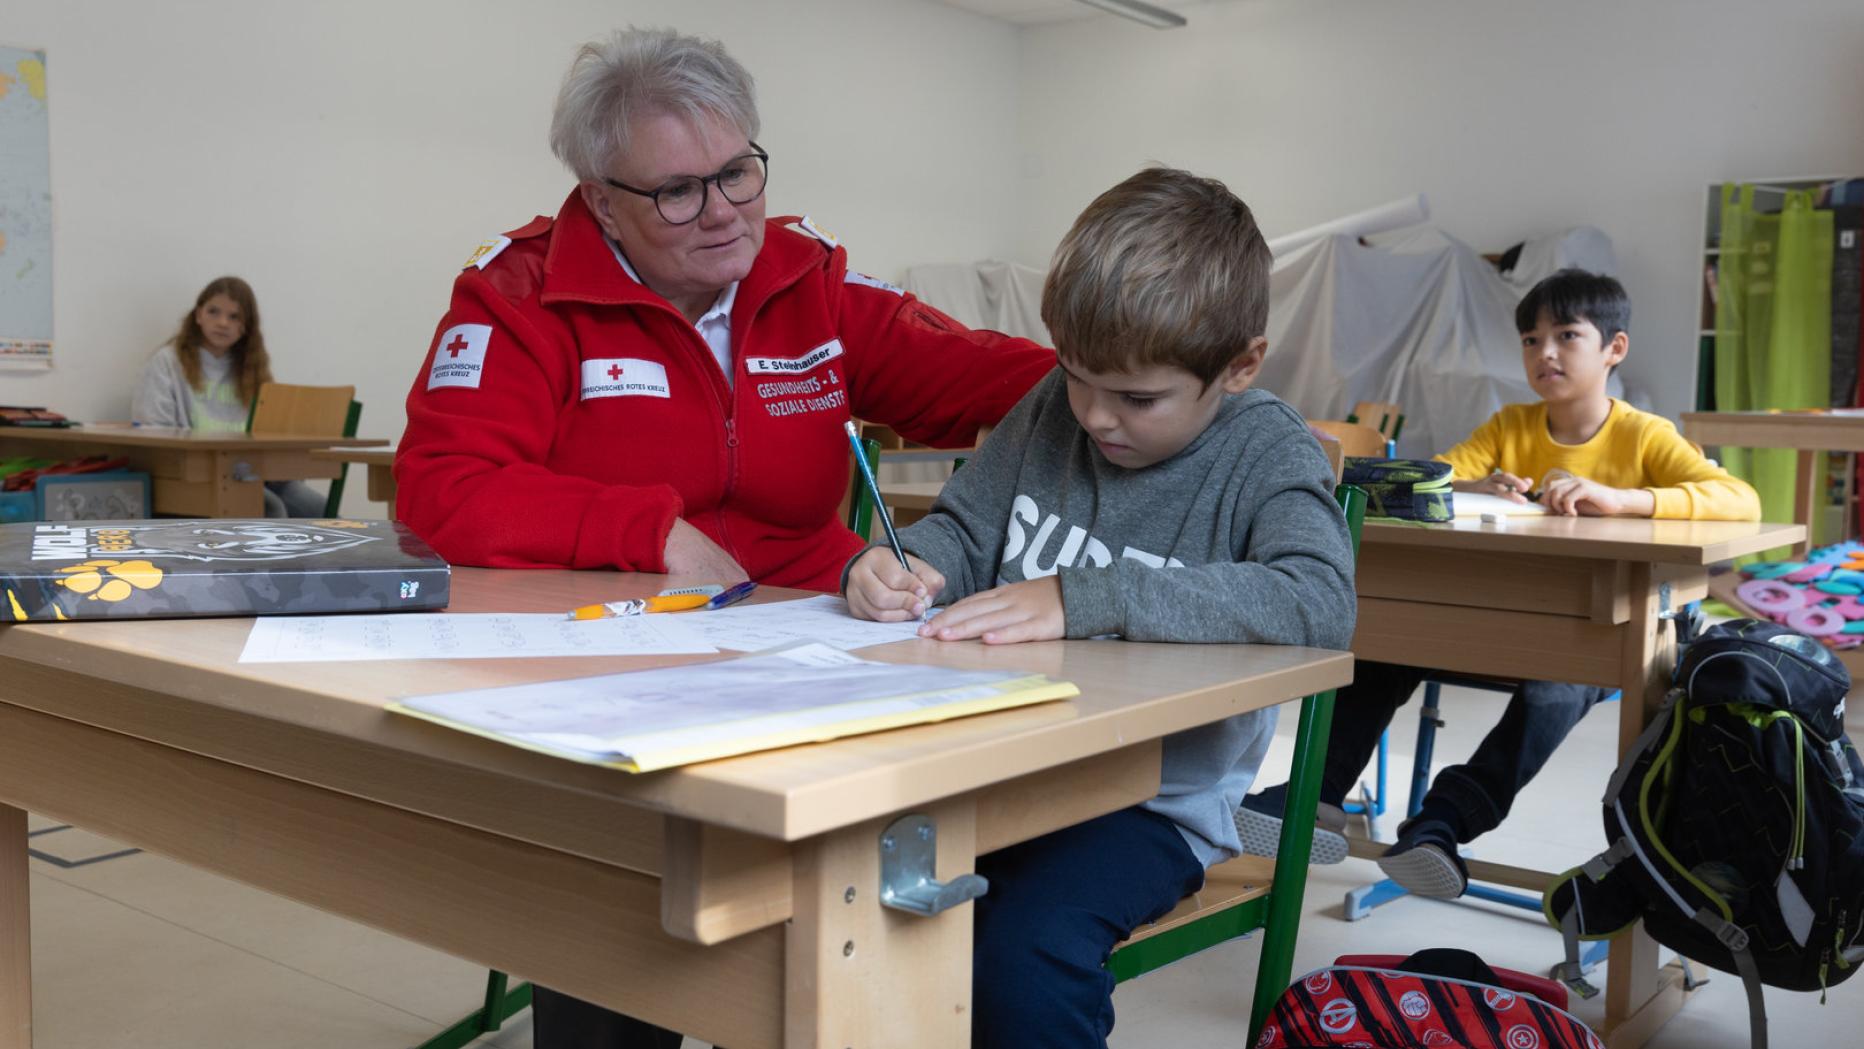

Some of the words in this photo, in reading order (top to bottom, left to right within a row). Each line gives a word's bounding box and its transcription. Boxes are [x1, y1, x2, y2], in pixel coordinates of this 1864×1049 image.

[626, 383, 646, 391] ROTES
[757, 376, 821, 399] GESUNDHEITS
[828, 369, 840, 385] &
[31, 525, 88, 560] WOLF
